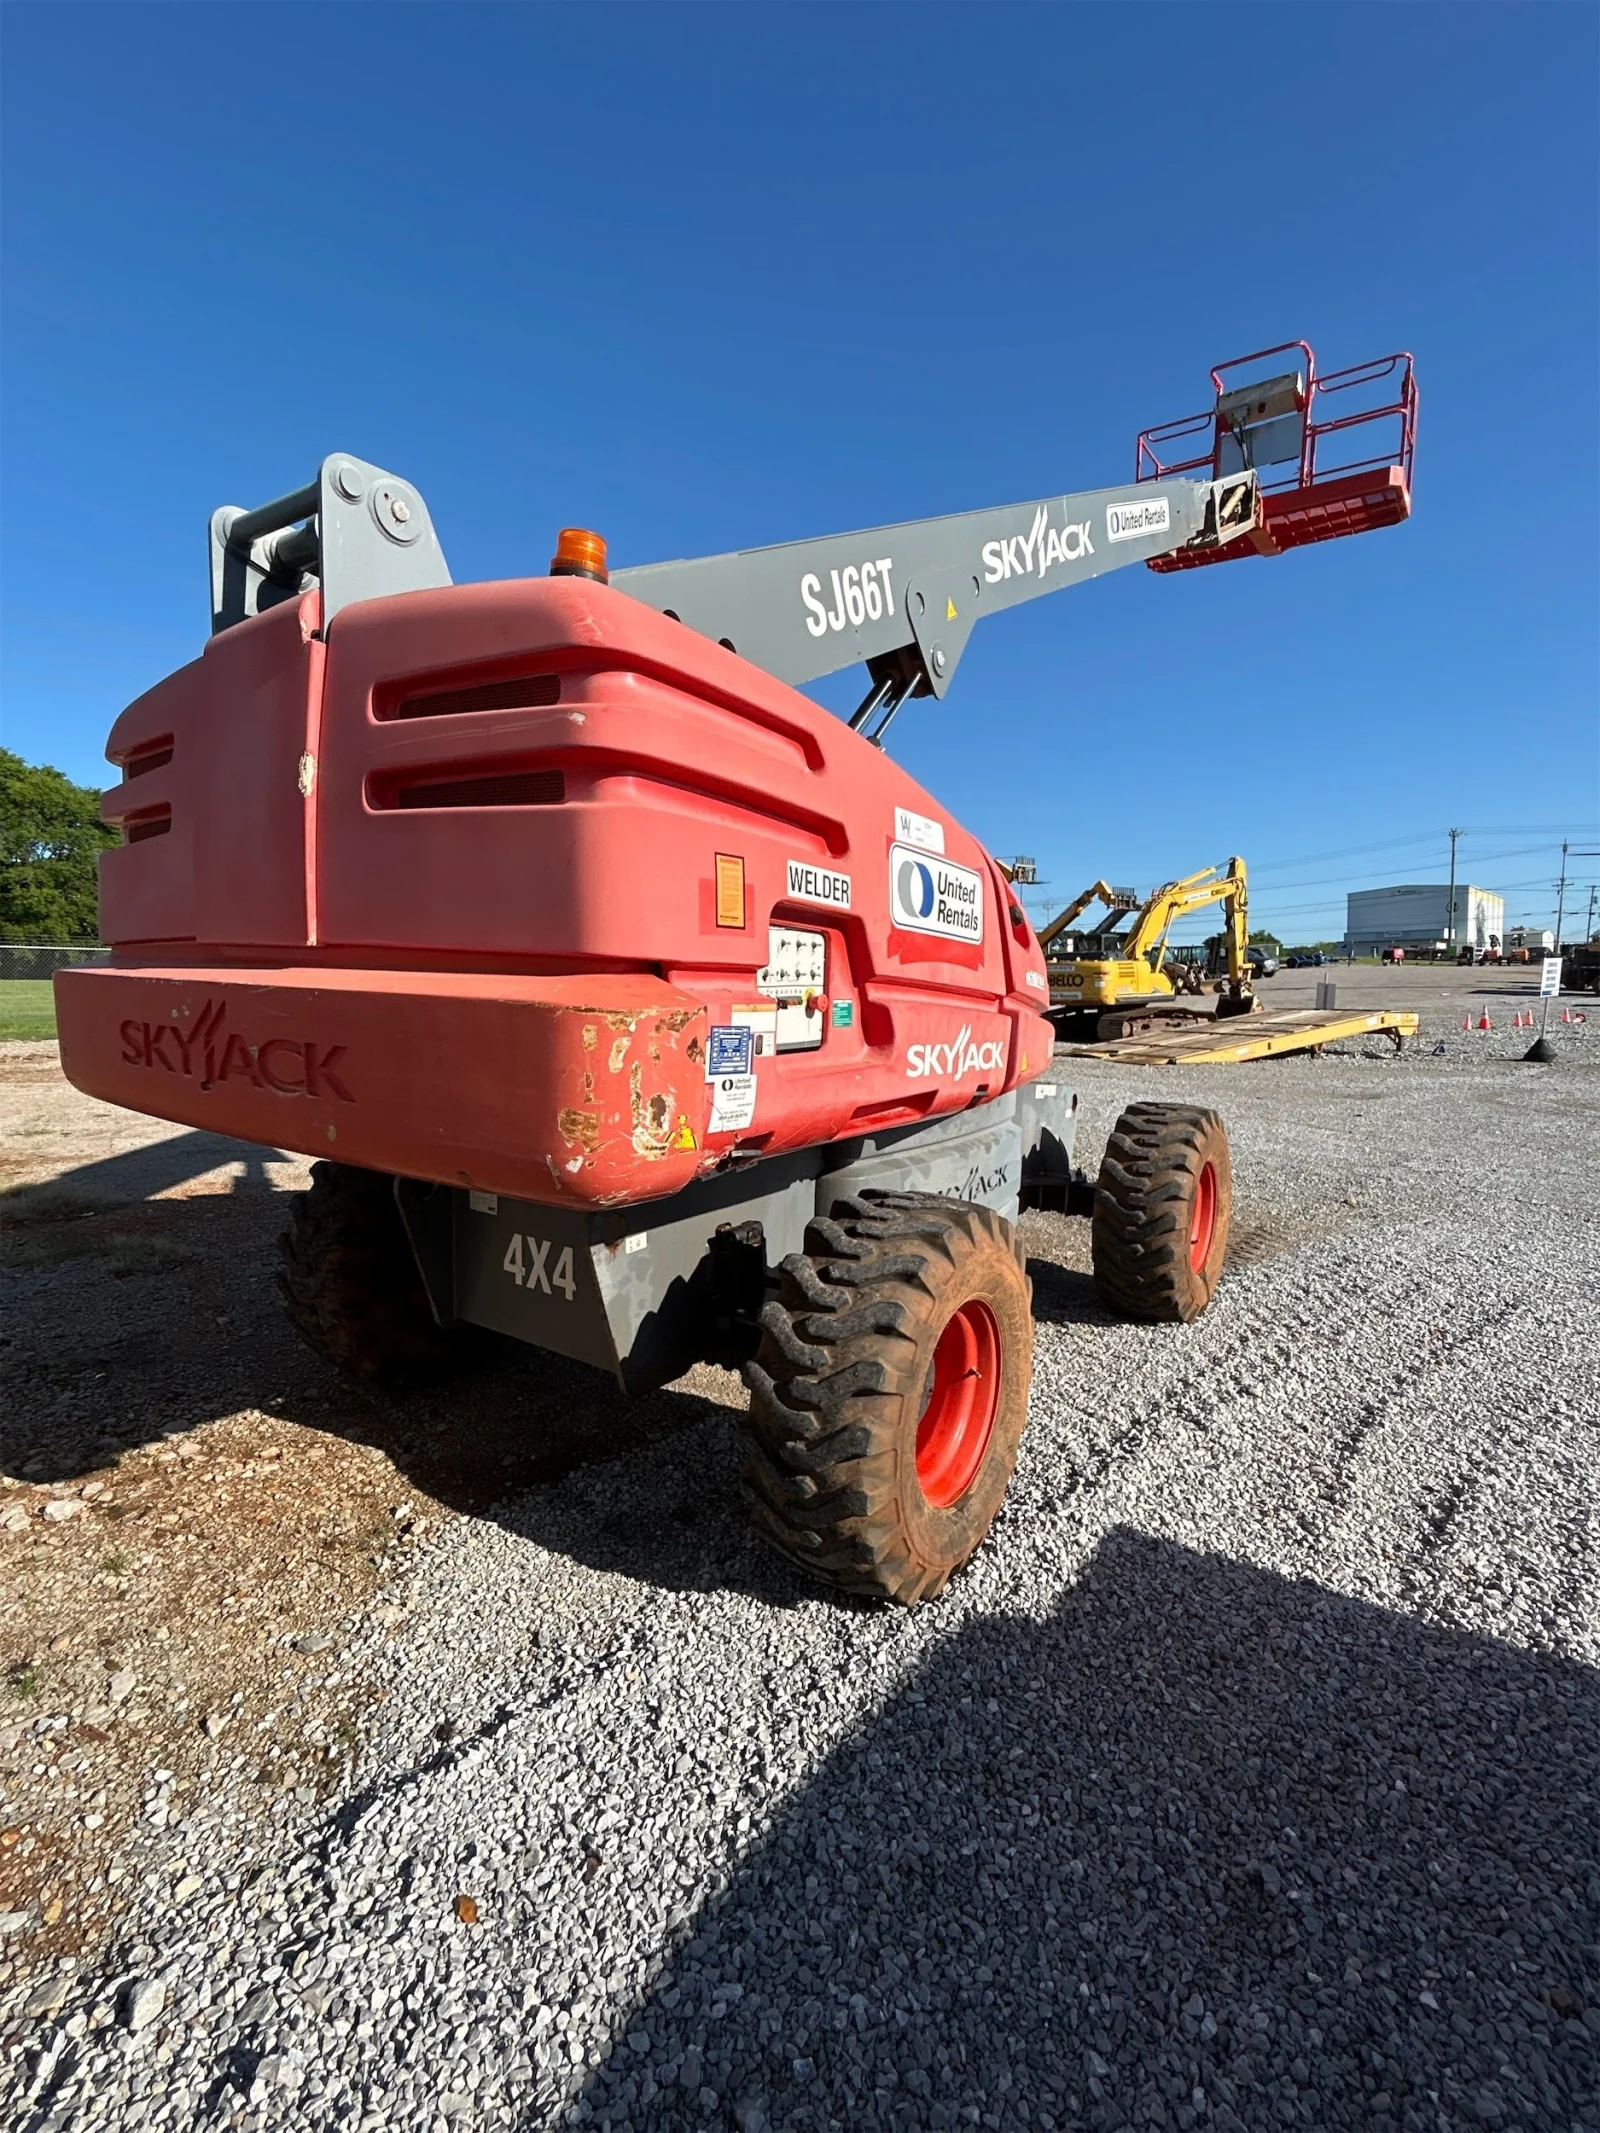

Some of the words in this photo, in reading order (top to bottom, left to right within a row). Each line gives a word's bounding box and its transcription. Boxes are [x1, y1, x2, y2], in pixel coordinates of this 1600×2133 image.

[981, 504, 1096, 584] SKYJACK
[1121, 509, 1143, 531] United
[1144, 505, 1166, 526] Rentals
[800, 557, 895, 637] SJ66T
[789, 865, 850, 904] WELDER
[937, 871, 976, 905] United
[937, 899, 979, 931] Rentals
[119, 997, 358, 1104] SKYJACK
[906, 1023, 1005, 1082] SKYJACK
[503, 1232, 577, 1301] 4X4
